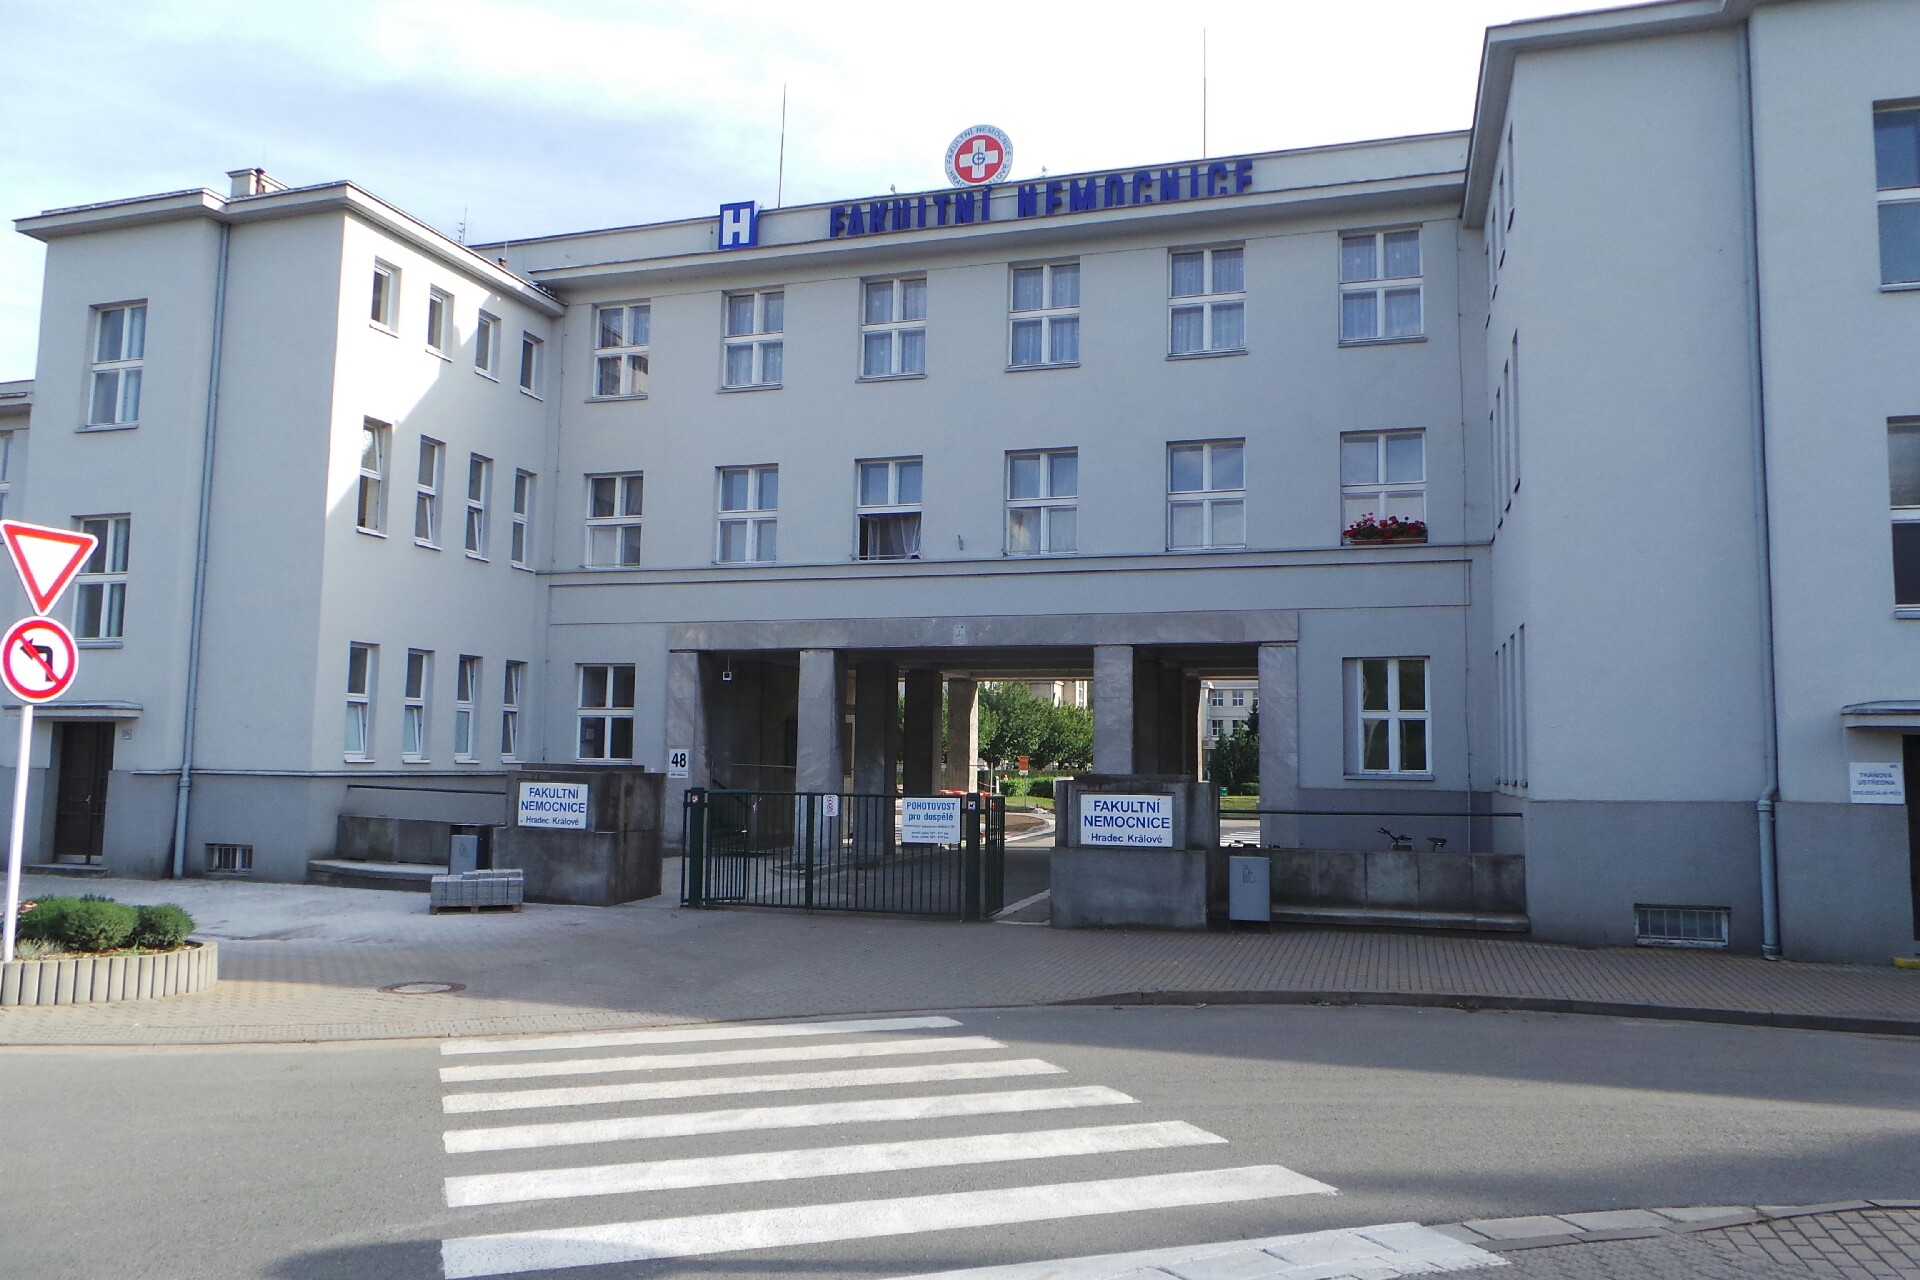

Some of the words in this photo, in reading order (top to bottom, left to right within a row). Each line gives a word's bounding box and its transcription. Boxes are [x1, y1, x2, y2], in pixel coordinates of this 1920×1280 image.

[976, 127, 1012, 156] NEMOCNICE
[722, 207, 751, 246] H
[671, 752, 687, 768] 48
[529, 786, 579, 799] FAKULTNÍ
[521, 800, 585, 813] NEMOCNICE
[906, 801, 956, 811] POHOTOVOST
[1093, 798, 1161, 813] FAKULTNÍ
[526, 816, 549, 824] Hradec
[553, 817, 579, 825] Králové
[908, 813, 921, 822] pro
[923, 812, 954, 822] dospělé
[1083, 815, 1170, 829] NEMOCNICE
[1091, 833, 1123, 842] Hradec
[1127, 834, 1162, 843] Králové
